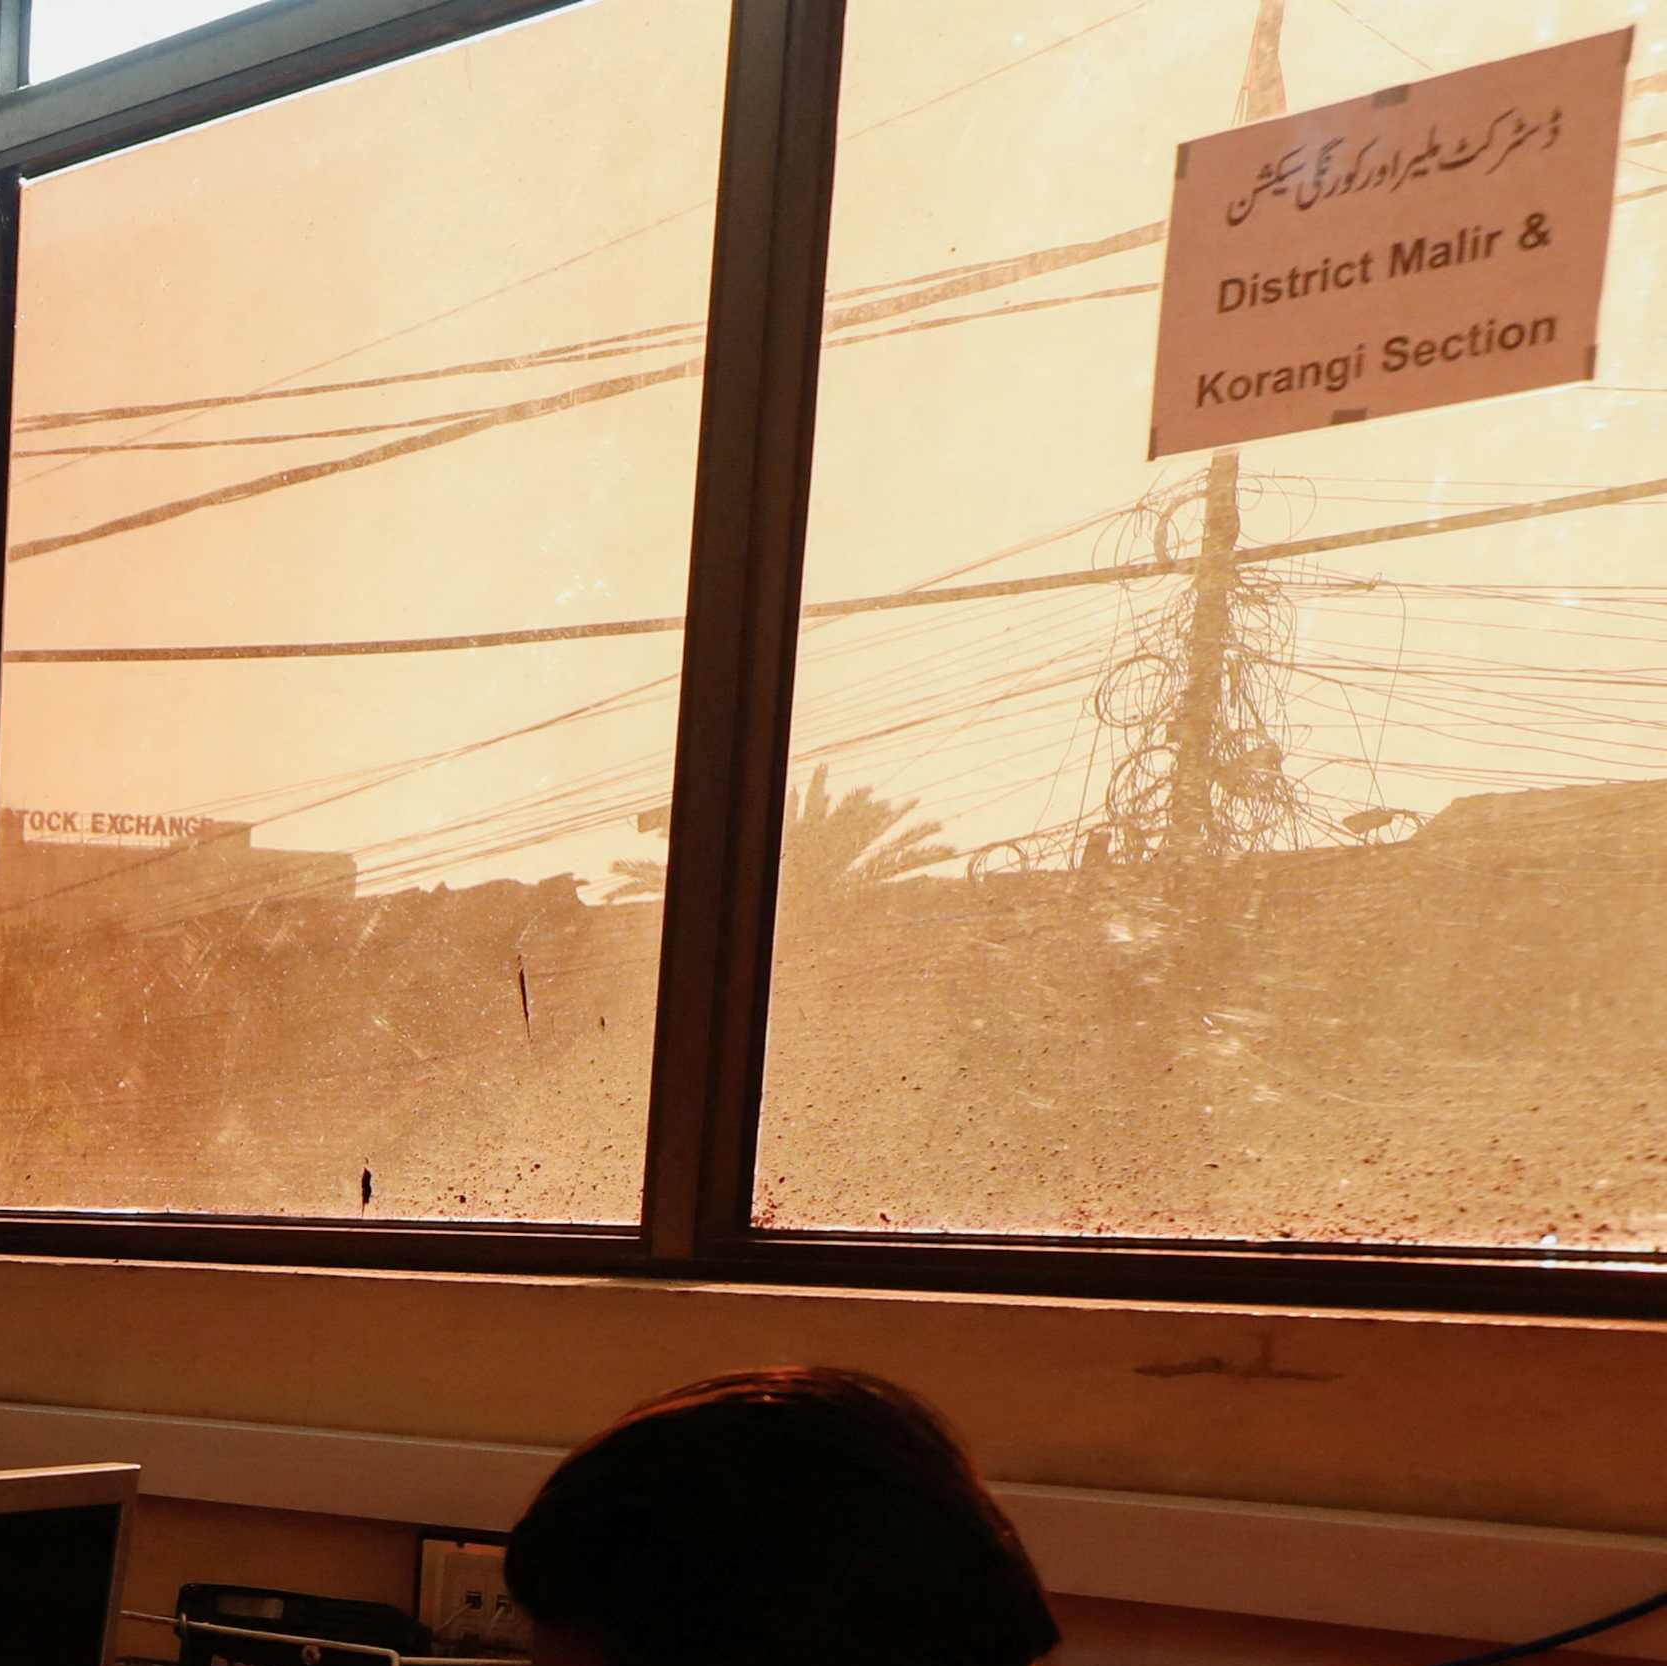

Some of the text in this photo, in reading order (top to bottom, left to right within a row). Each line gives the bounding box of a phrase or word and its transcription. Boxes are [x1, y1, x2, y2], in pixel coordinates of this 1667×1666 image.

[1226, 106, 1563, 226] ڈسٹرکٹ ملیر اور کورنگی سیکشن
[1216, 211, 1551, 314] District Malir &
[1195, 315, 1558, 409] Korangi Section
[5, 809, 79, 832] TOCK
